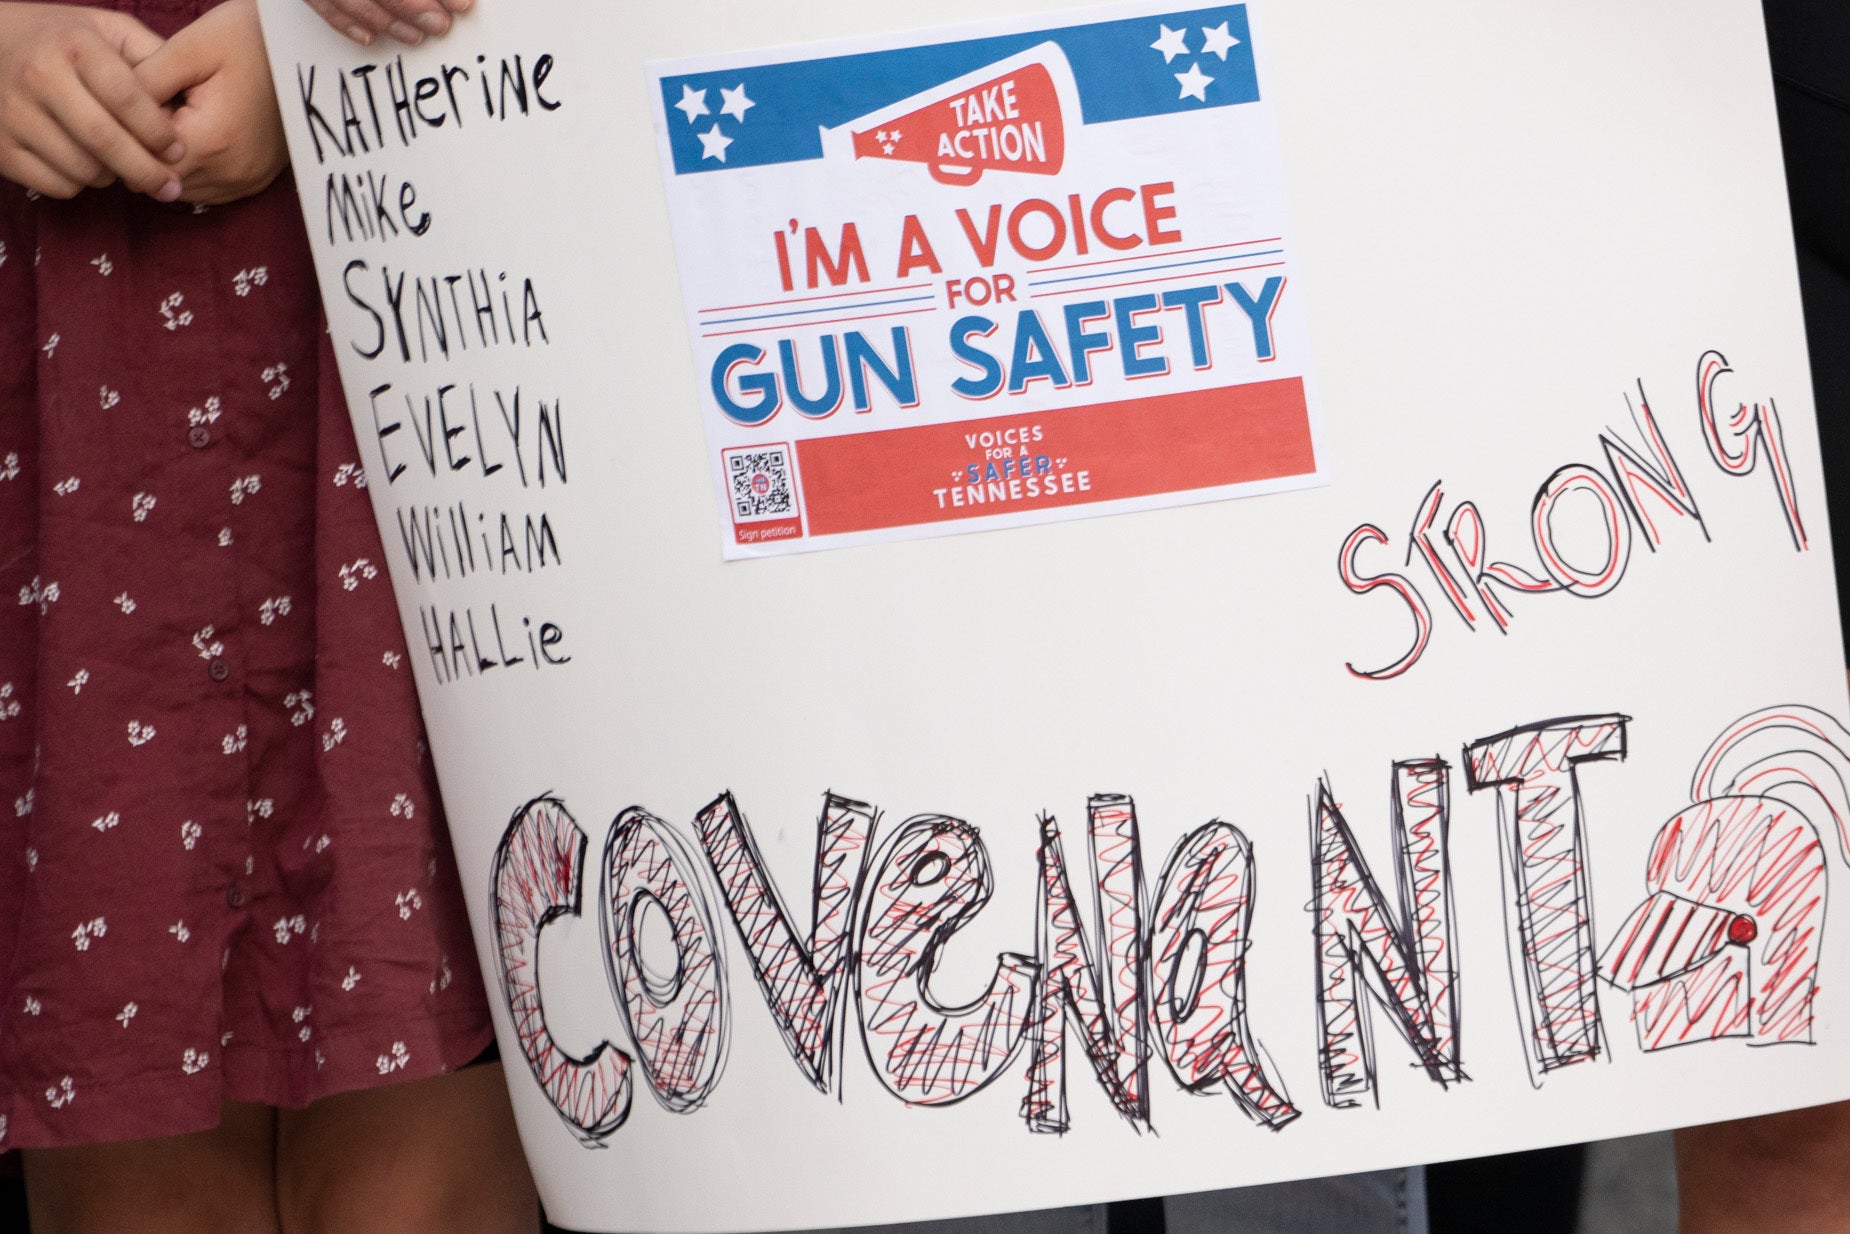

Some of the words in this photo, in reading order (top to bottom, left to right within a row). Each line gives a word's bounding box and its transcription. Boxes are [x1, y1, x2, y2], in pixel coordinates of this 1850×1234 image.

[949, 80, 1020, 128] TAKE
[937, 121, 1047, 163] ACTION
[774, 217, 871, 292] I'M
[897, 214, 943, 279] A
[955, 181, 1183, 263] VOICE
[944, 273, 1018, 310] FOR
[711, 325, 921, 428] GUN
[949, 275, 1288, 400] SAFETY
[368, 382, 568, 489] EVELYN
[965, 425, 1044, 449] VOICES
[985, 447, 1012, 460] FOR
[1019, 445, 1029, 457] A
[966, 454, 1053, 484] SAFER
[933, 470, 1092, 509] TENNESSEE
[738, 529, 760, 542] Sign
[760, 526, 796, 541] petition
[1339, 350, 1810, 680] STRONG
